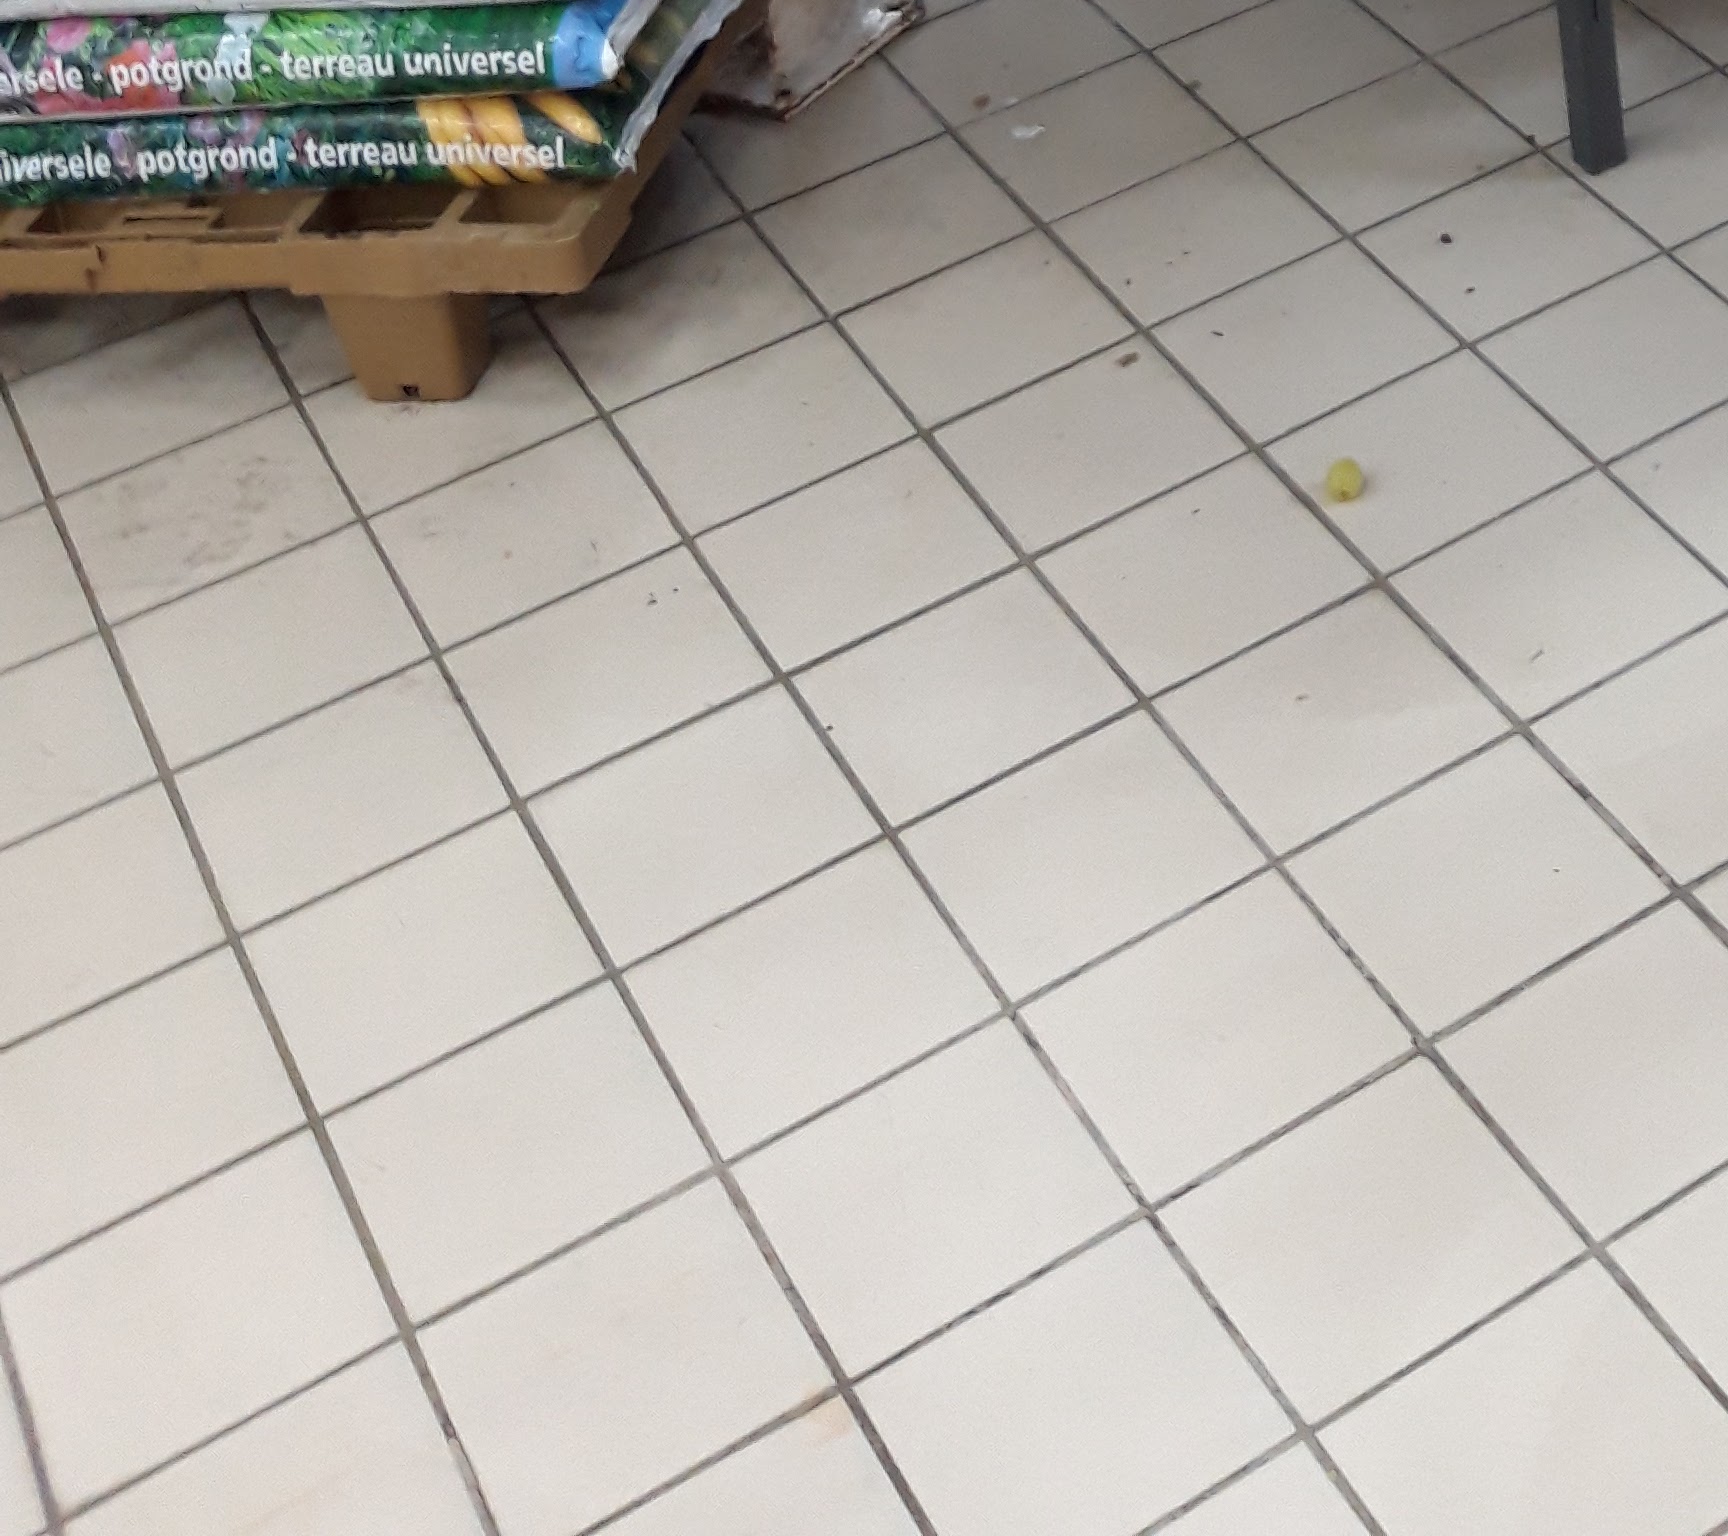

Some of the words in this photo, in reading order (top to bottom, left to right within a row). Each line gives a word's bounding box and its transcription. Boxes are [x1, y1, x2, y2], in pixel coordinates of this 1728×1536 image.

[110, 50, 251, 95] potgrond
[280, 47, 396, 81] terreau
[403, 42, 546, 78] universel
[137, 135, 278, 183] potgrond
[303, 136, 418, 171] terreau
[425, 135, 567, 172] universel
